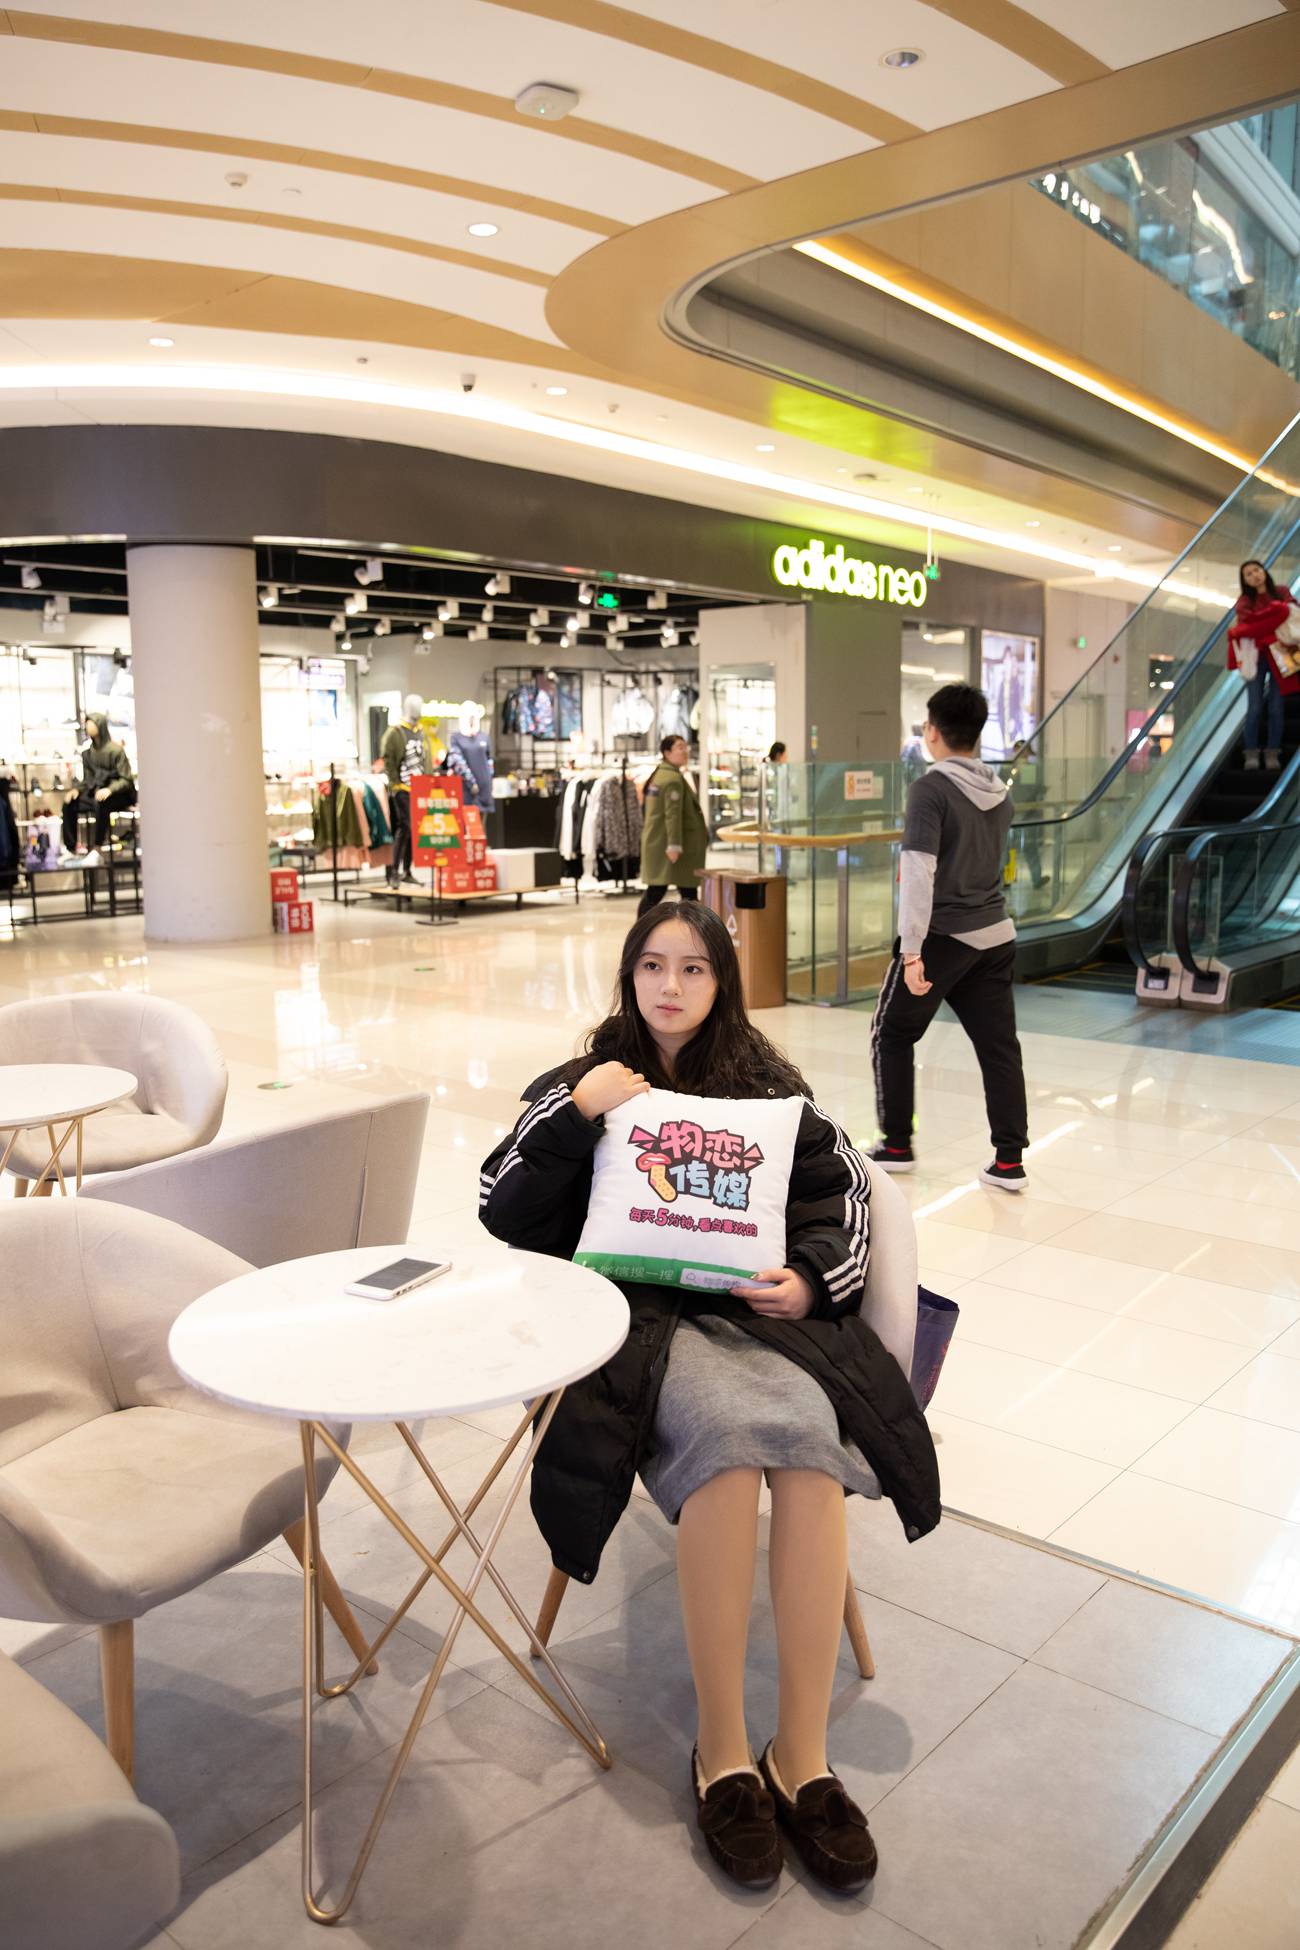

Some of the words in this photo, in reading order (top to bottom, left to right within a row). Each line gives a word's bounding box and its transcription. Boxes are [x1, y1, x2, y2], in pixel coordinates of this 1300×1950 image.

[774, 539, 877, 600] adidas
[878, 564, 928, 607] neo
[659, 1120, 743, 1169] 物恋
[668, 1160, 750, 1209] 传媒
